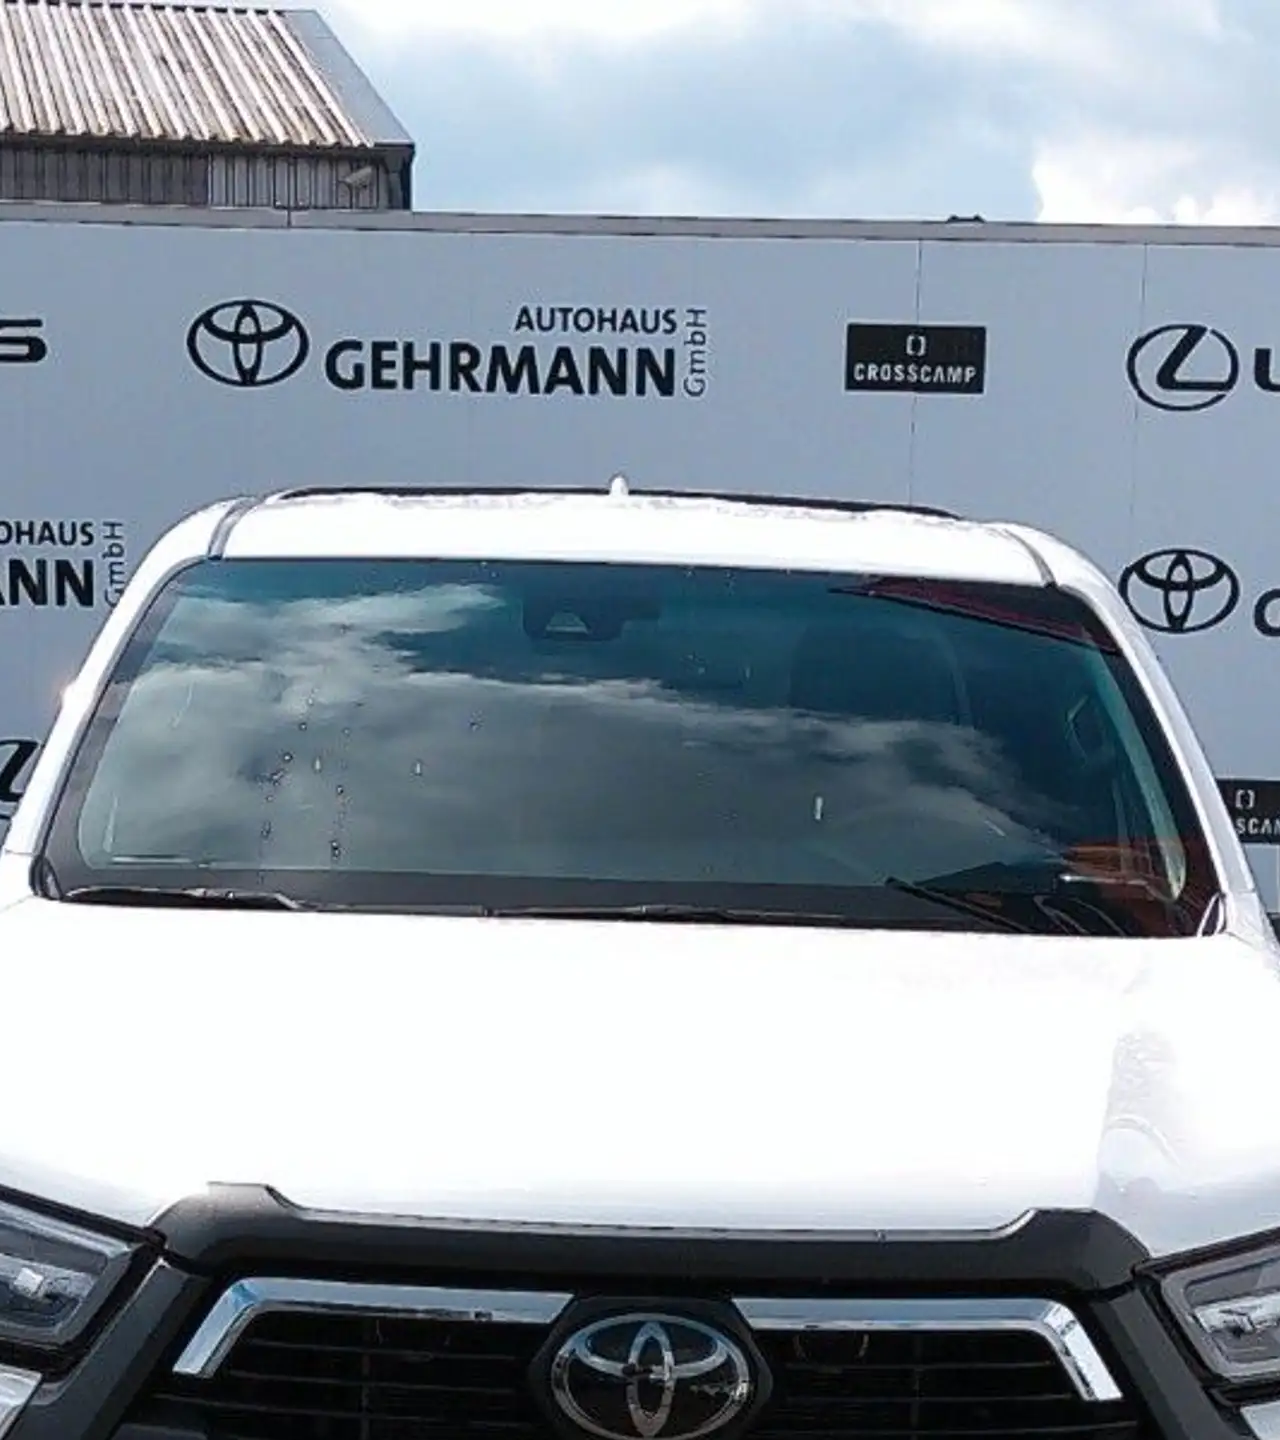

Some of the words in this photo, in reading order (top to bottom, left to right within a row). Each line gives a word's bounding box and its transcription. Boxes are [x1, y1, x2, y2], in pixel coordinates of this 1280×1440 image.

[515, 306, 677, 334] AUTOHAUS
[325, 340, 675, 396] GEHRMANN
[684, 308, 706, 397] GmbH
[855, 364, 975, 382] CROSSCAMP
